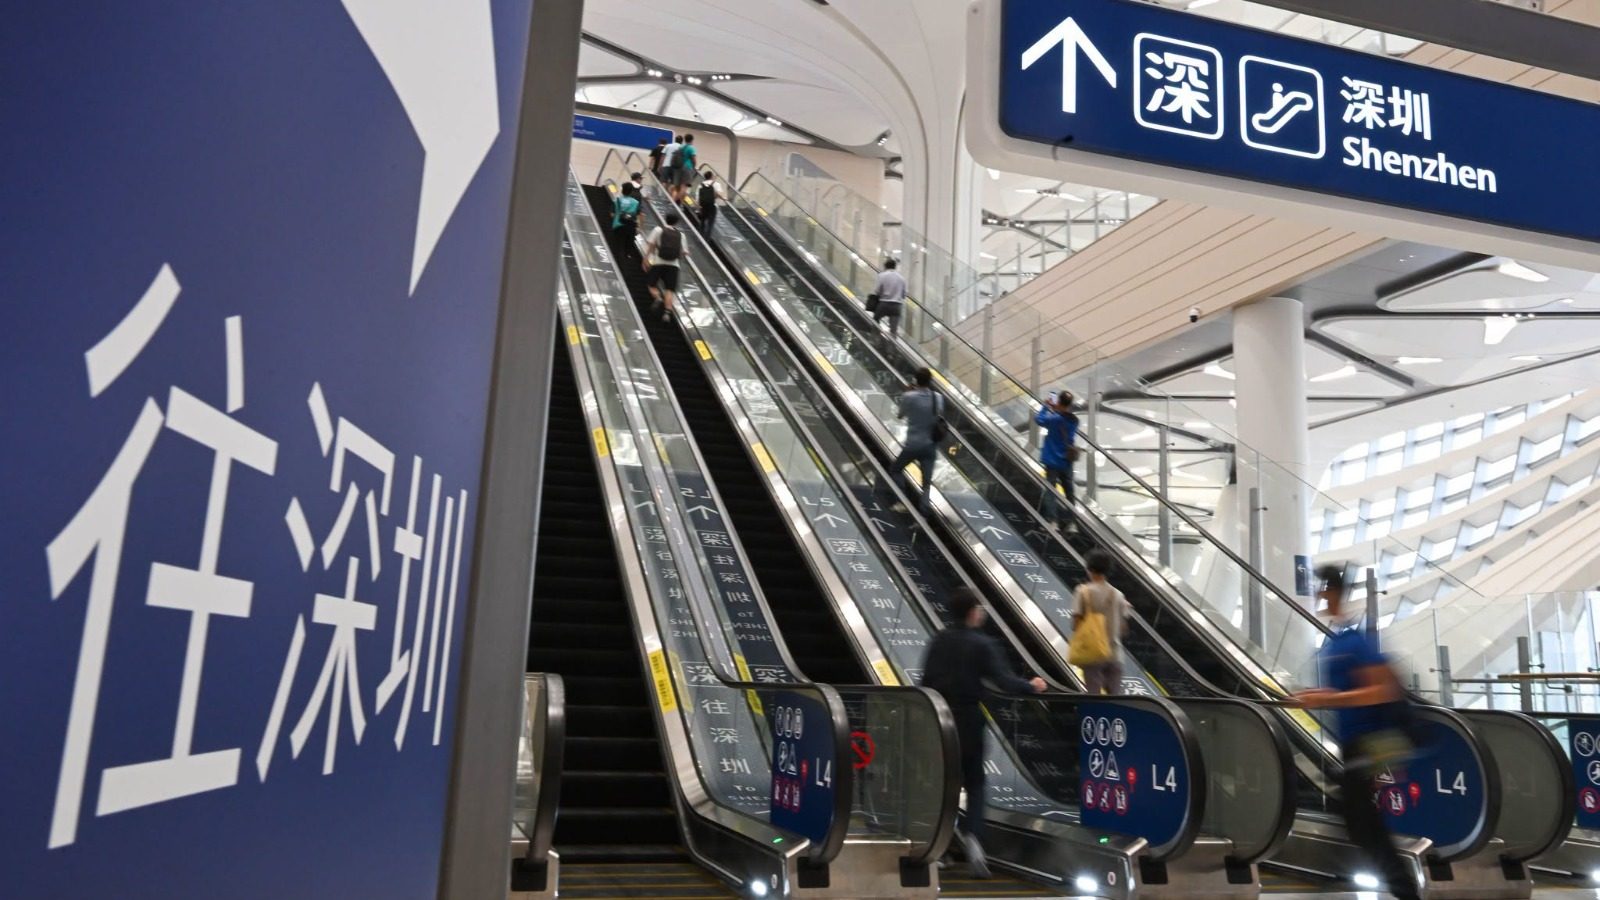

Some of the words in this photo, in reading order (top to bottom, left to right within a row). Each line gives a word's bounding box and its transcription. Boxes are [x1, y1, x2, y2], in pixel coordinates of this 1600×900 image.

[1145, 51, 1212, 124] 深
[1340, 76, 1432, 141] 深圳
[1343, 136, 1497, 193] Shenzhen
[802, 496, 835, 507] L5
[962, 508, 995, 520] L5
[46, 263, 468, 849] 往深圳
[832, 541, 861, 553] 深
[848, 561, 896, 609] 往深圳
[881, 627, 919, 635] SHEN
[702, 699, 751, 774] 往深圳
[815, 757, 832, 788] L4
[1152, 764, 1177, 792] L4
[1435, 768, 1467, 796] L4
